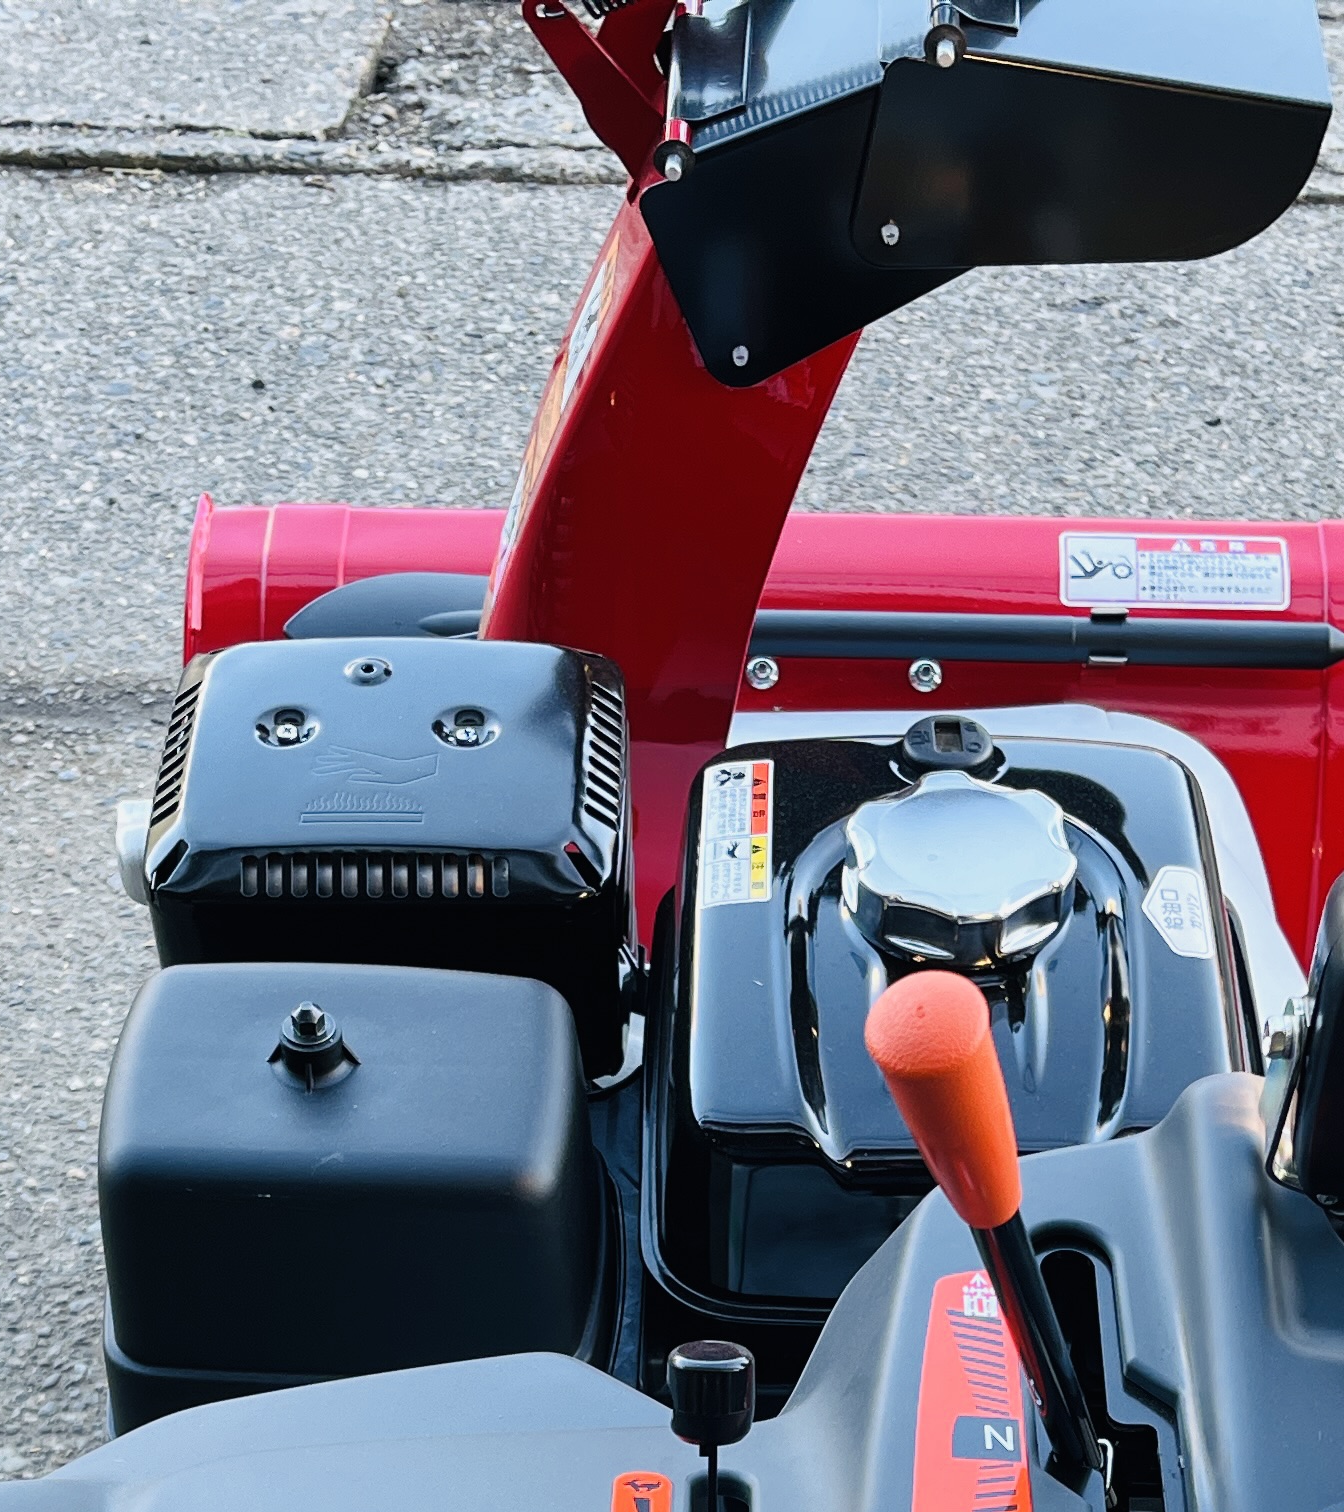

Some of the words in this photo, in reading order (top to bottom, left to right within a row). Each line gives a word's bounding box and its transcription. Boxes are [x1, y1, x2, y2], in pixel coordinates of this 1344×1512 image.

[1160, 888, 1184, 929] 給油口
[984, 1424, 1014, 1451] N
